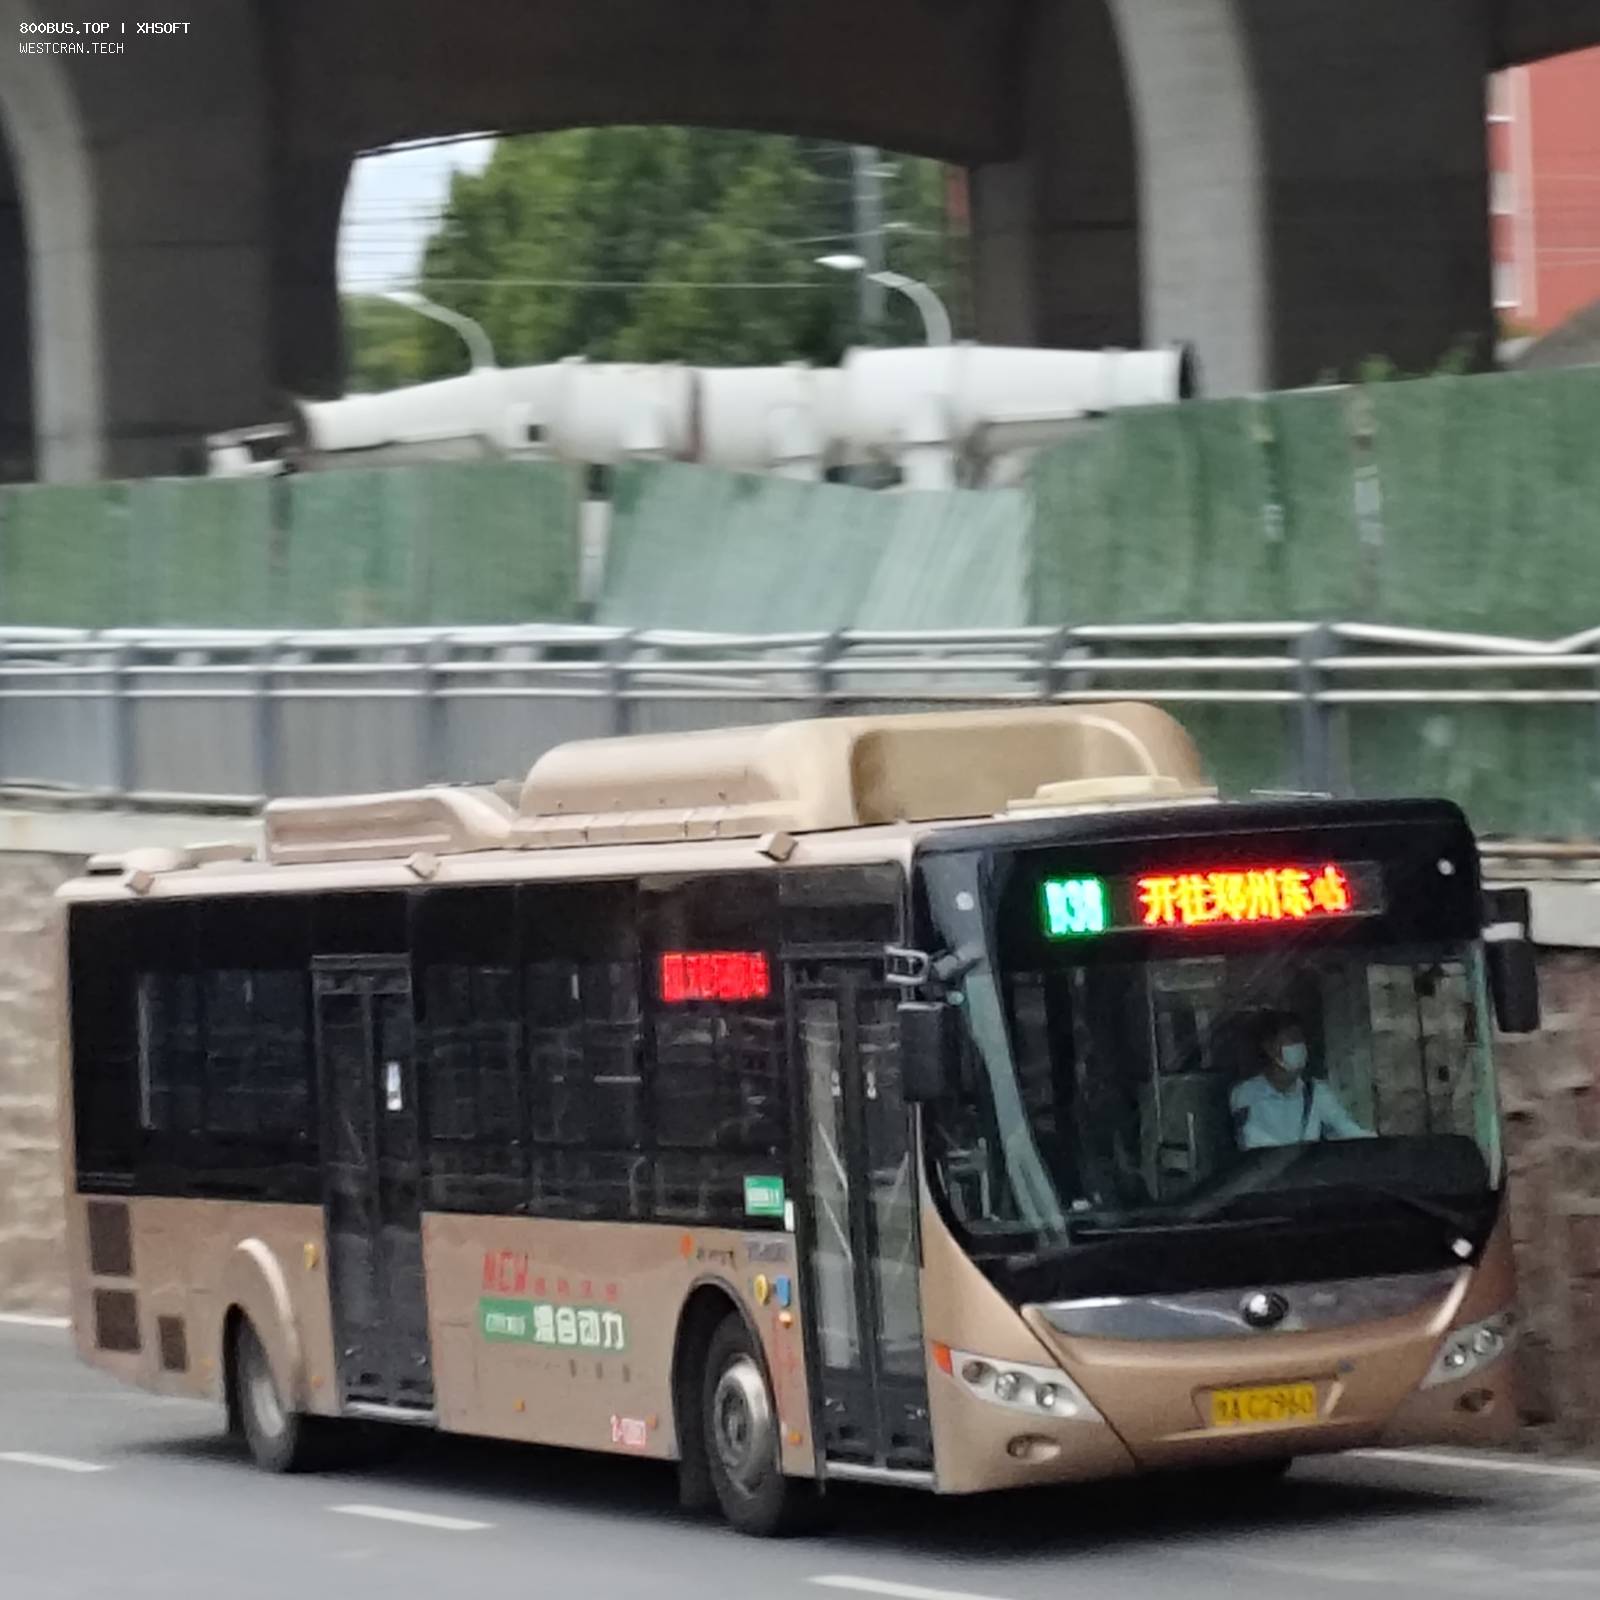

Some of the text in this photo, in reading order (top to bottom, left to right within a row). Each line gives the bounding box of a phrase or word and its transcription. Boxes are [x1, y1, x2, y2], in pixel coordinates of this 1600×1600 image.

[1137, 865, 1349, 926] 开往郑州东站
